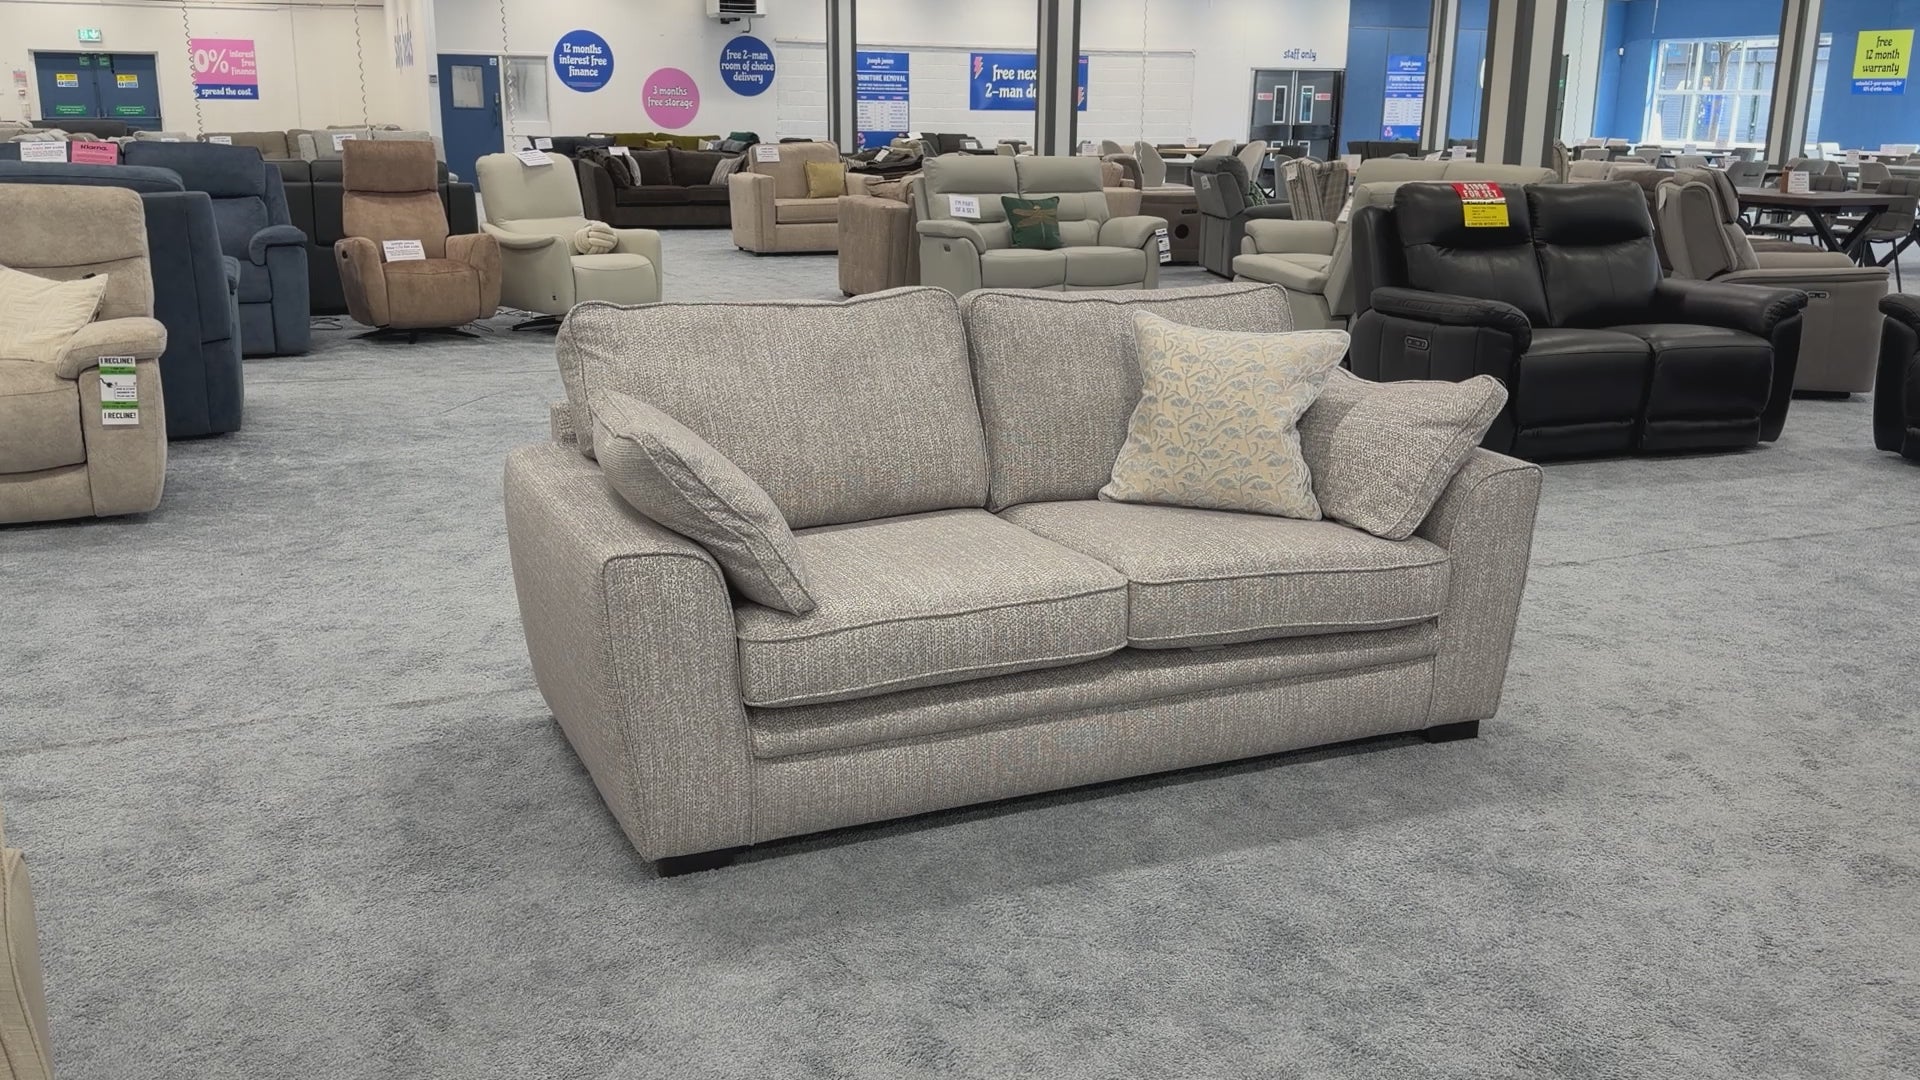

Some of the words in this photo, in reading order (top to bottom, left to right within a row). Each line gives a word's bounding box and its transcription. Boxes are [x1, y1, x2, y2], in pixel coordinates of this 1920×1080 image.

[1876, 35, 1893, 48] free
[229, 49, 254, 58] interest
[563, 43, 571, 52] 12
[572, 44, 602, 54] months
[726, 49, 741, 60] free
[742, 49, 768, 60] 2-man
[1283, 48, 1300, 60] staff
[1301, 49, 1317, 61] only
[1866, 49, 1873, 60] 12
[1874, 48, 1900, 60] month
[194, 48, 229, 73] 0%
[241, 58, 255, 67] free
[559, 54, 590, 65] interest
[591, 55, 607, 66] free
[742, 60, 750, 71] of
[751, 60, 775, 71] choice
[231, 66, 256, 76] finance
[568, 65, 599, 77] finance
[992, 64, 1015, 82] free
[1016, 69, 1037, 80] nex
[1862, 63, 1900, 76] warranty
[733, 71, 764, 84] delivery
[201, 87, 225, 97] spread
[226, 87, 237, 96] the
[237, 88, 254, 96] cost.
[653, 85, 658, 95] 3
[659, 86, 688, 96] months
[985, 83, 1023, 98] 2-man
[648, 96, 663, 107] free
[664, 98, 694, 110] storage
